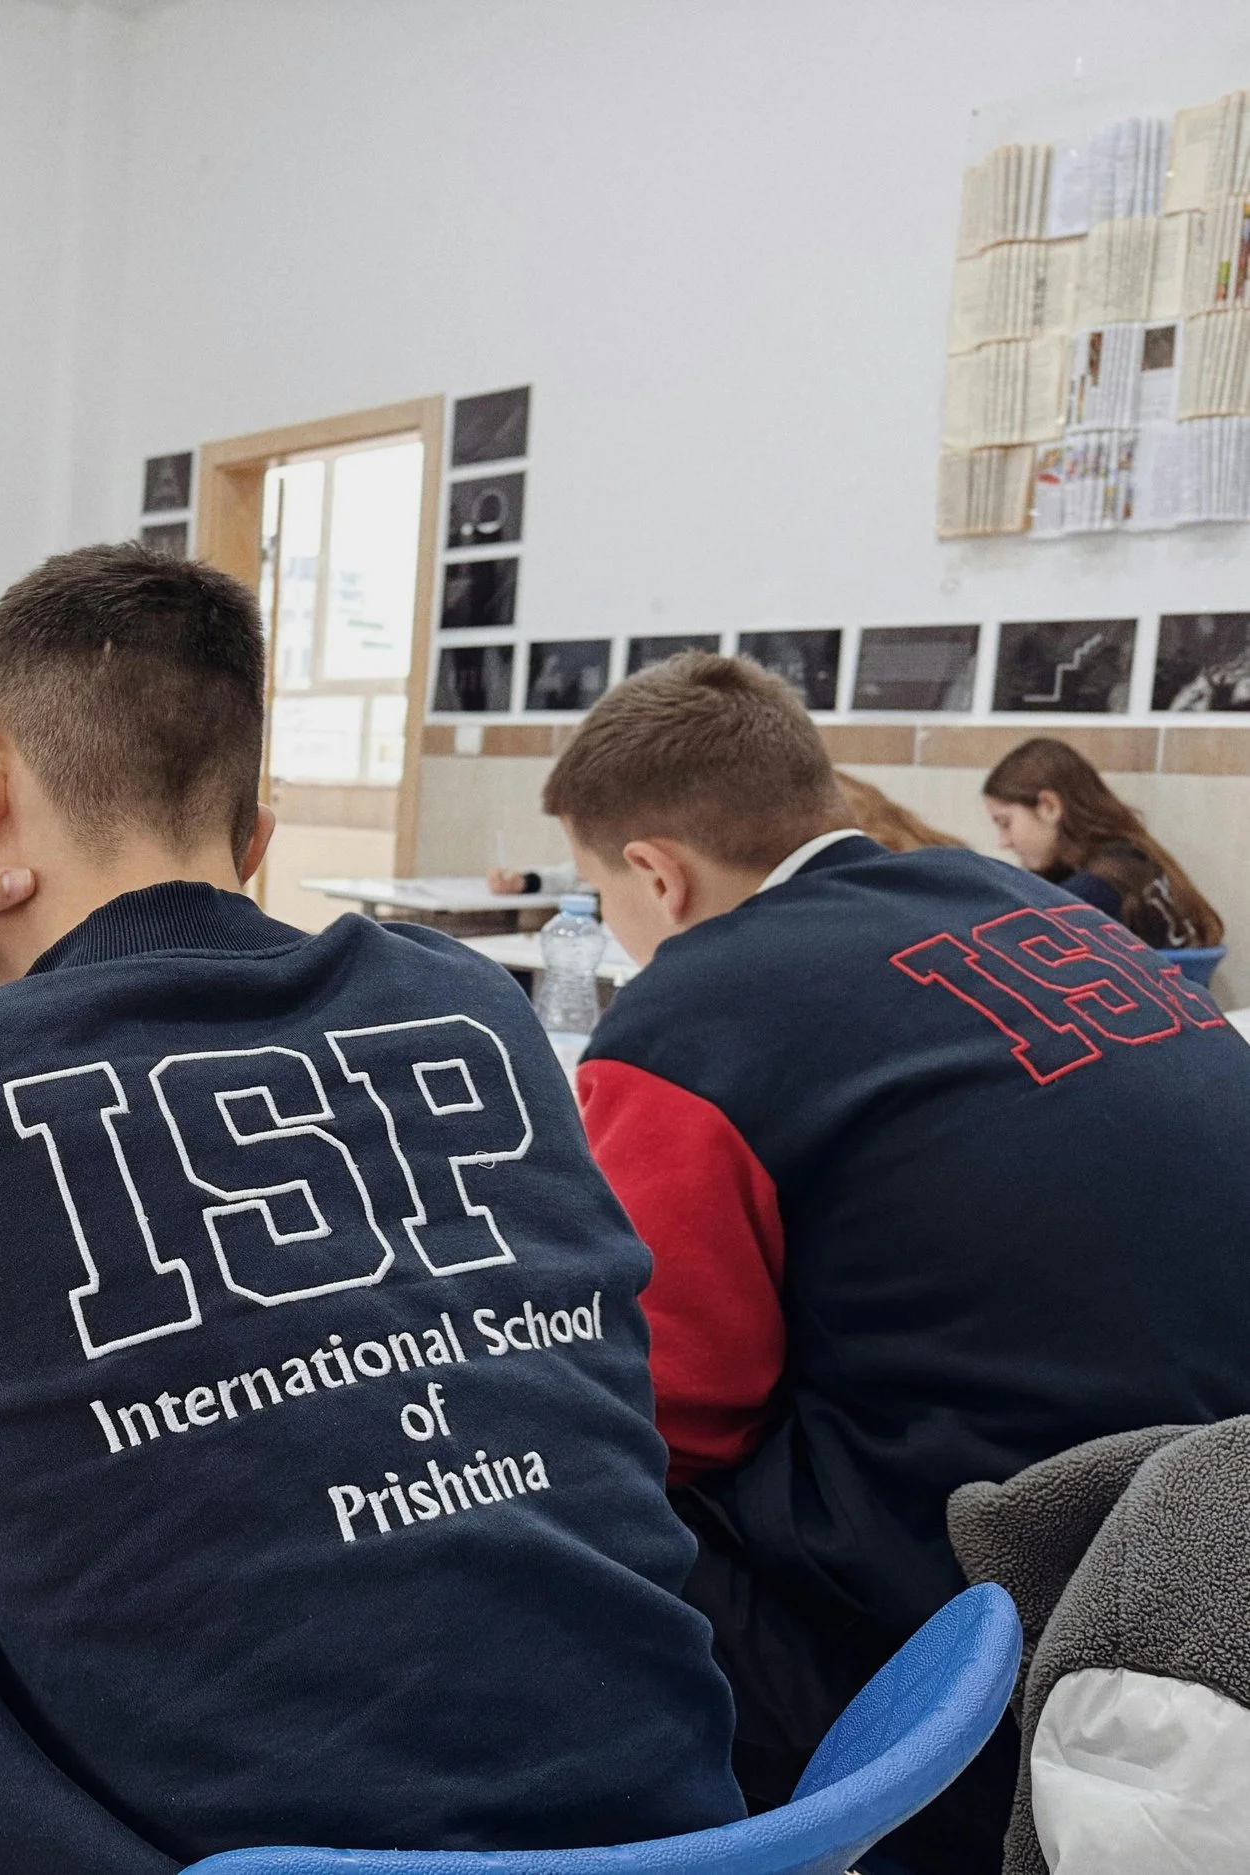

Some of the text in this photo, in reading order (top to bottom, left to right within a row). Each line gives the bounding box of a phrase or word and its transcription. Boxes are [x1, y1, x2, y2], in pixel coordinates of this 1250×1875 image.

[3, 1014, 534, 1360] ISP
[89, 1290, 605, 1454] International School
[400, 1382, 452, 1442] of
[327, 1449, 551, 1542] Prishtina
